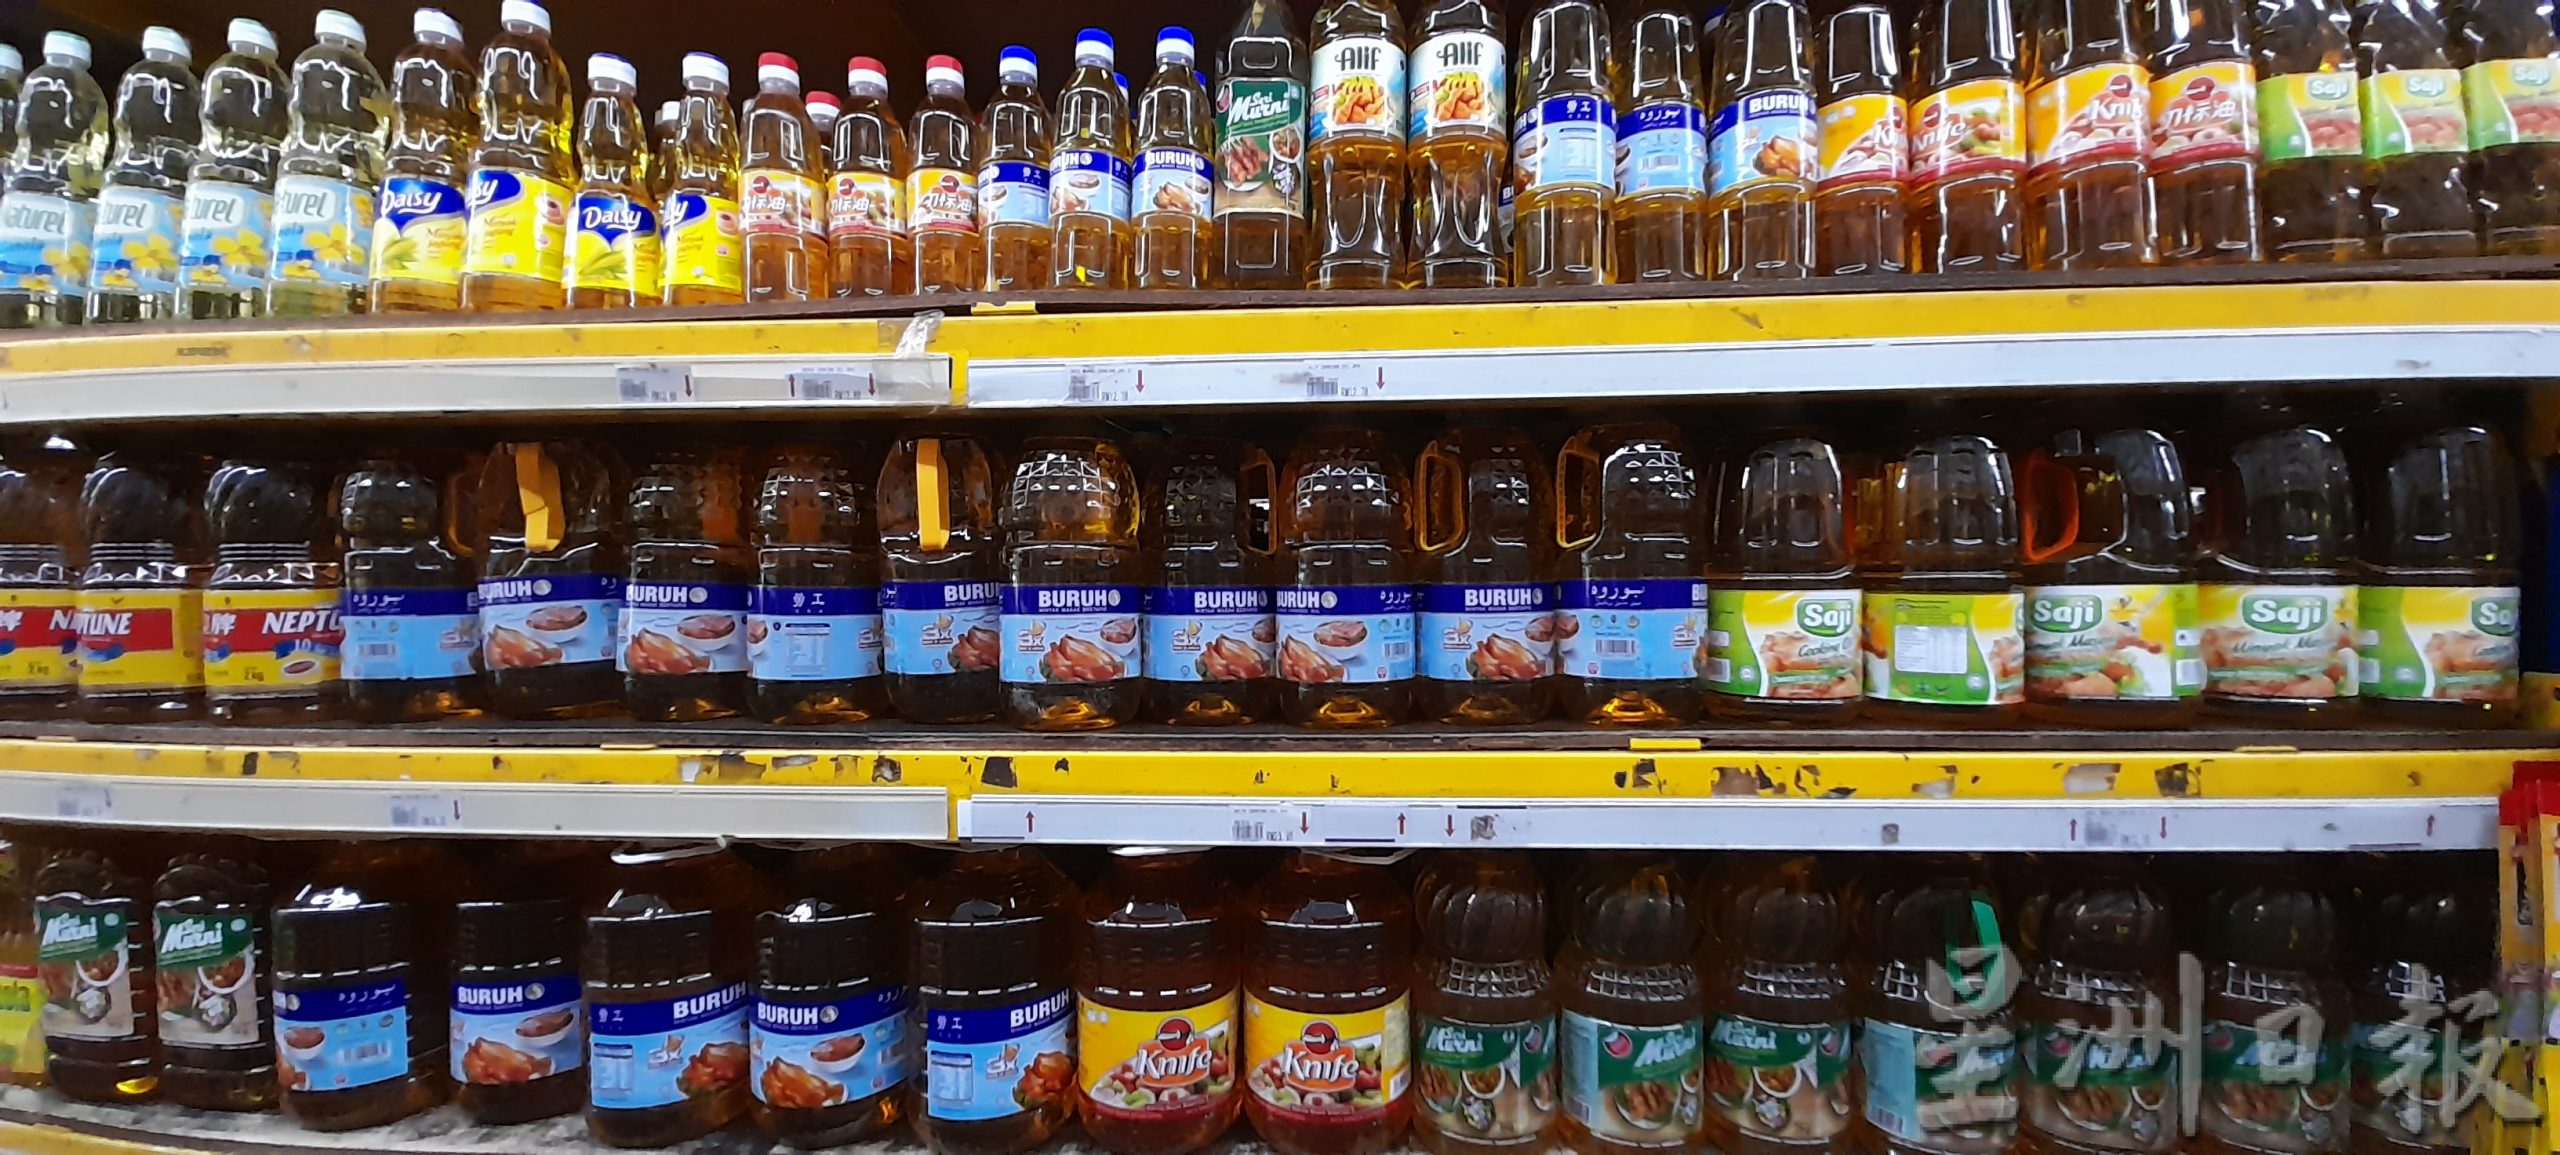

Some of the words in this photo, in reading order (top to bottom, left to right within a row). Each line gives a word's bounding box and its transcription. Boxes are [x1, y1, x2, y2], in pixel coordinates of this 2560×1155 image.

[1336, 46, 1382, 71] Alif
[1436, 42, 1483, 67] Alif
[2408, 76, 2444, 97] Saji
[2515, 65, 2550, 86] Saji
[2312, 79, 2348, 99] Saji
[1226, 92, 1289, 127] Murni
[382, 187, 443, 215] Daisy
[584, 206, 643, 230] Daisy
[626, 585, 688, 604] BURUH
[1038, 590, 1109, 607] BURUH
[1194, 591, 1259, 608] BURUH
[1465, 588, 1532, 606] BURUH
[1803, 603, 1851, 635] Saji
[2033, 600, 2095, 630] Saji
[2250, 600, 2321, 631] Saji
[458, 986, 524, 1006] BURUH
[673, 981, 747, 1020] BURUH
[1010, 988, 1070, 1028] BURUH
[757, 1002, 819, 1025] BURUH
[1136, 1047, 1213, 1080] Knife
[1281, 1047, 1360, 1082] Knife
